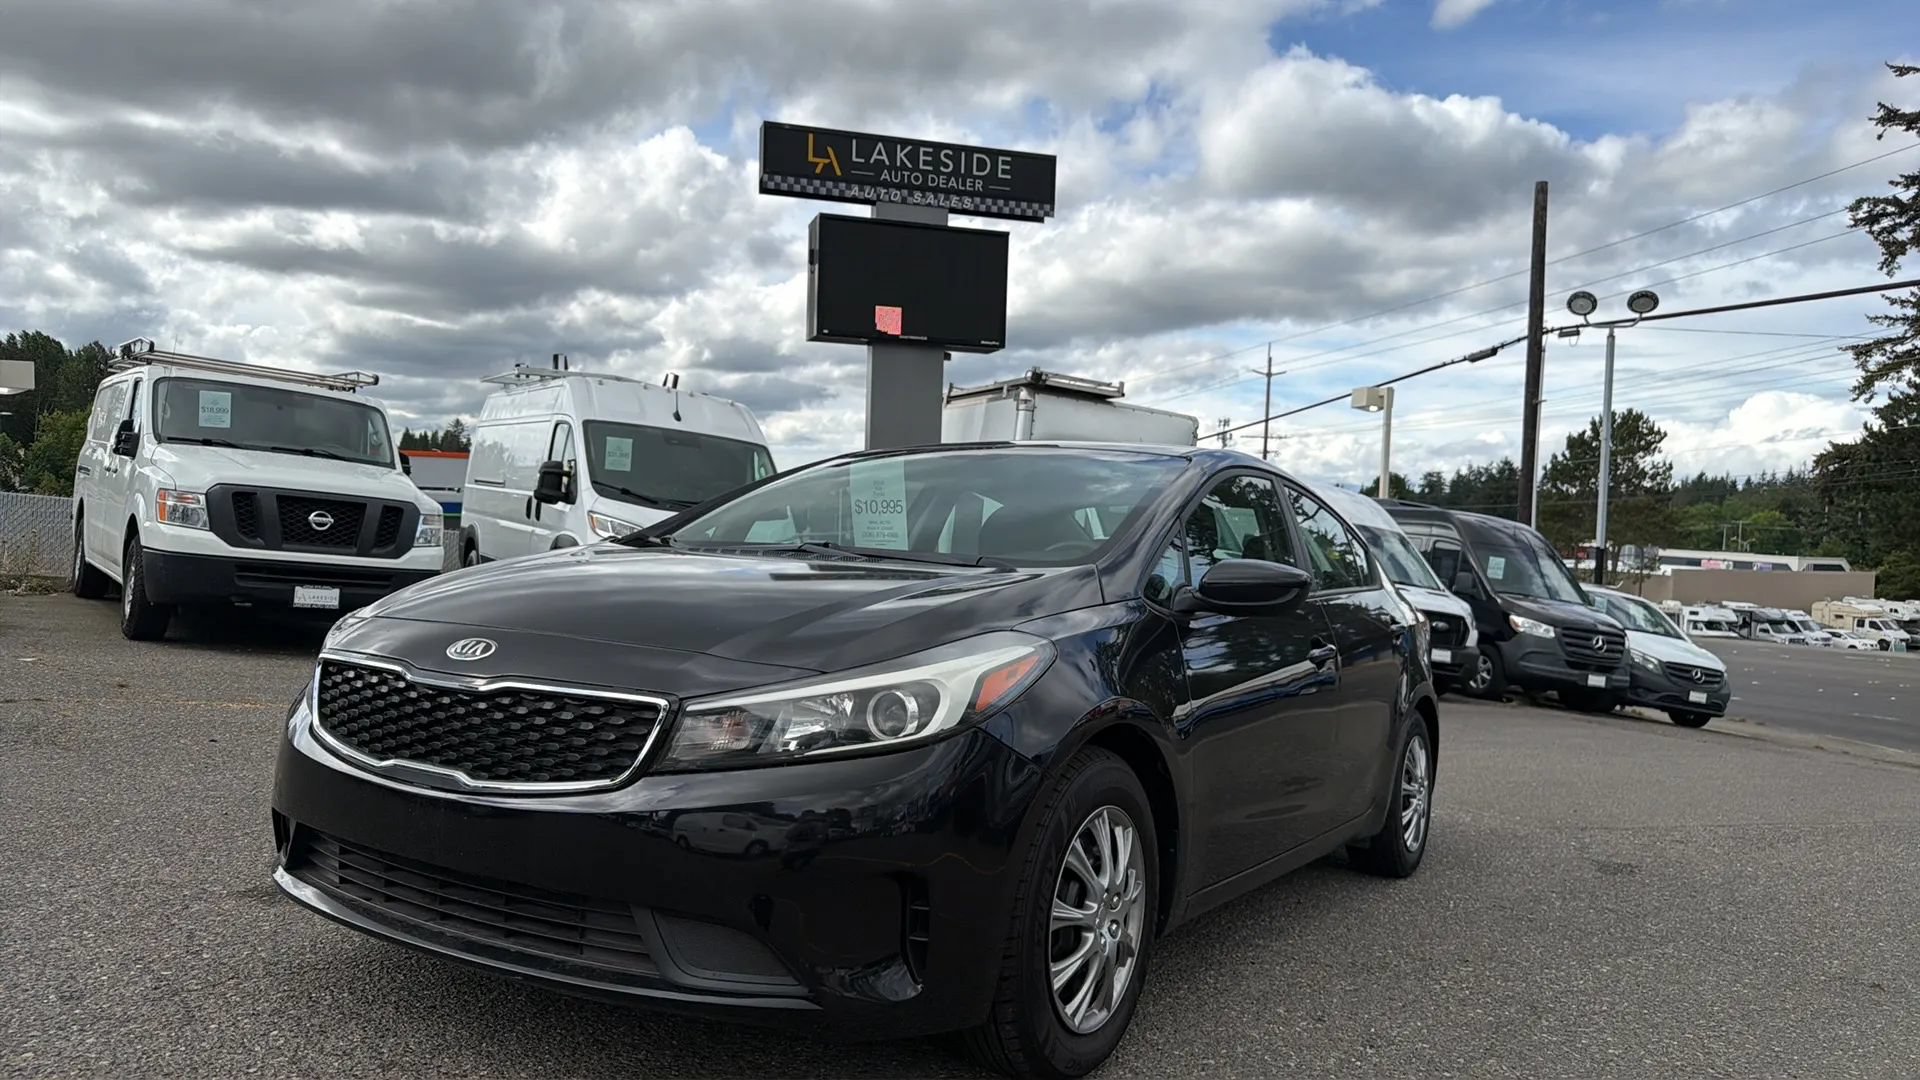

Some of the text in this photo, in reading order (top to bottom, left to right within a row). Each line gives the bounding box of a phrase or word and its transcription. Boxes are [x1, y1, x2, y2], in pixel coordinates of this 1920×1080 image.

[851, 138, 1012, 180] LAKESIDE
[880, 169, 984, 192] AUTO DEALER
[850, 185, 975, 209] AUTO SALES
[854, 499, 903, 515] $10,995
[451, 639, 487, 656] KIA
